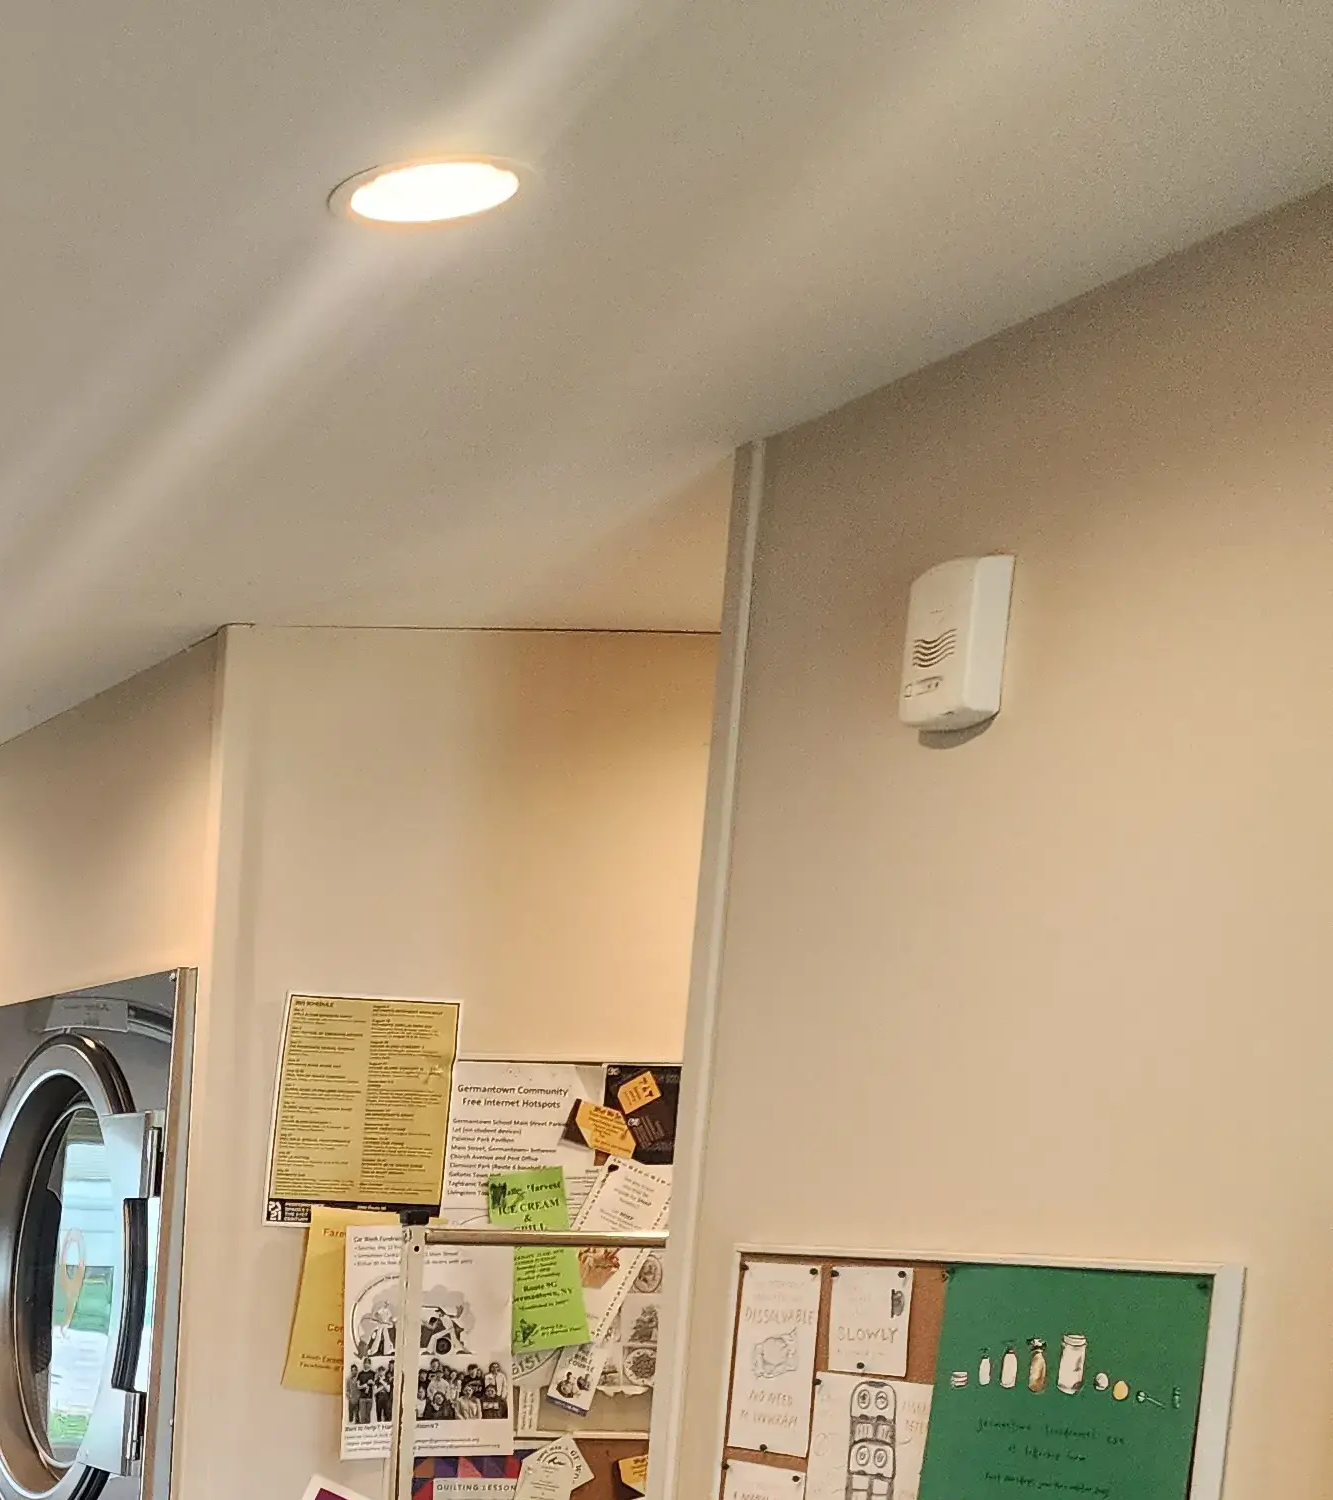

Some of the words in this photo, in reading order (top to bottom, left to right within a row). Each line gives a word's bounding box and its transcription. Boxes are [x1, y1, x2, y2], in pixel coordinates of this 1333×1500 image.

[457, 1084, 516, 1095] Germantown
[518, 1086, 569, 1097] Community
[462, 1097, 482, 1106] Free
[484, 1098, 520, 1107] Internet
[522, 1100, 561, 1109] Hotspots
[519, 1198, 560, 1213] CREAM
[523, 1213, 532, 1223] &
[60, 1227, 86, 1338] 9
[837, 1327, 900, 1344] SLOWLY
[437, 1484, 479, 1492] QUILTING
